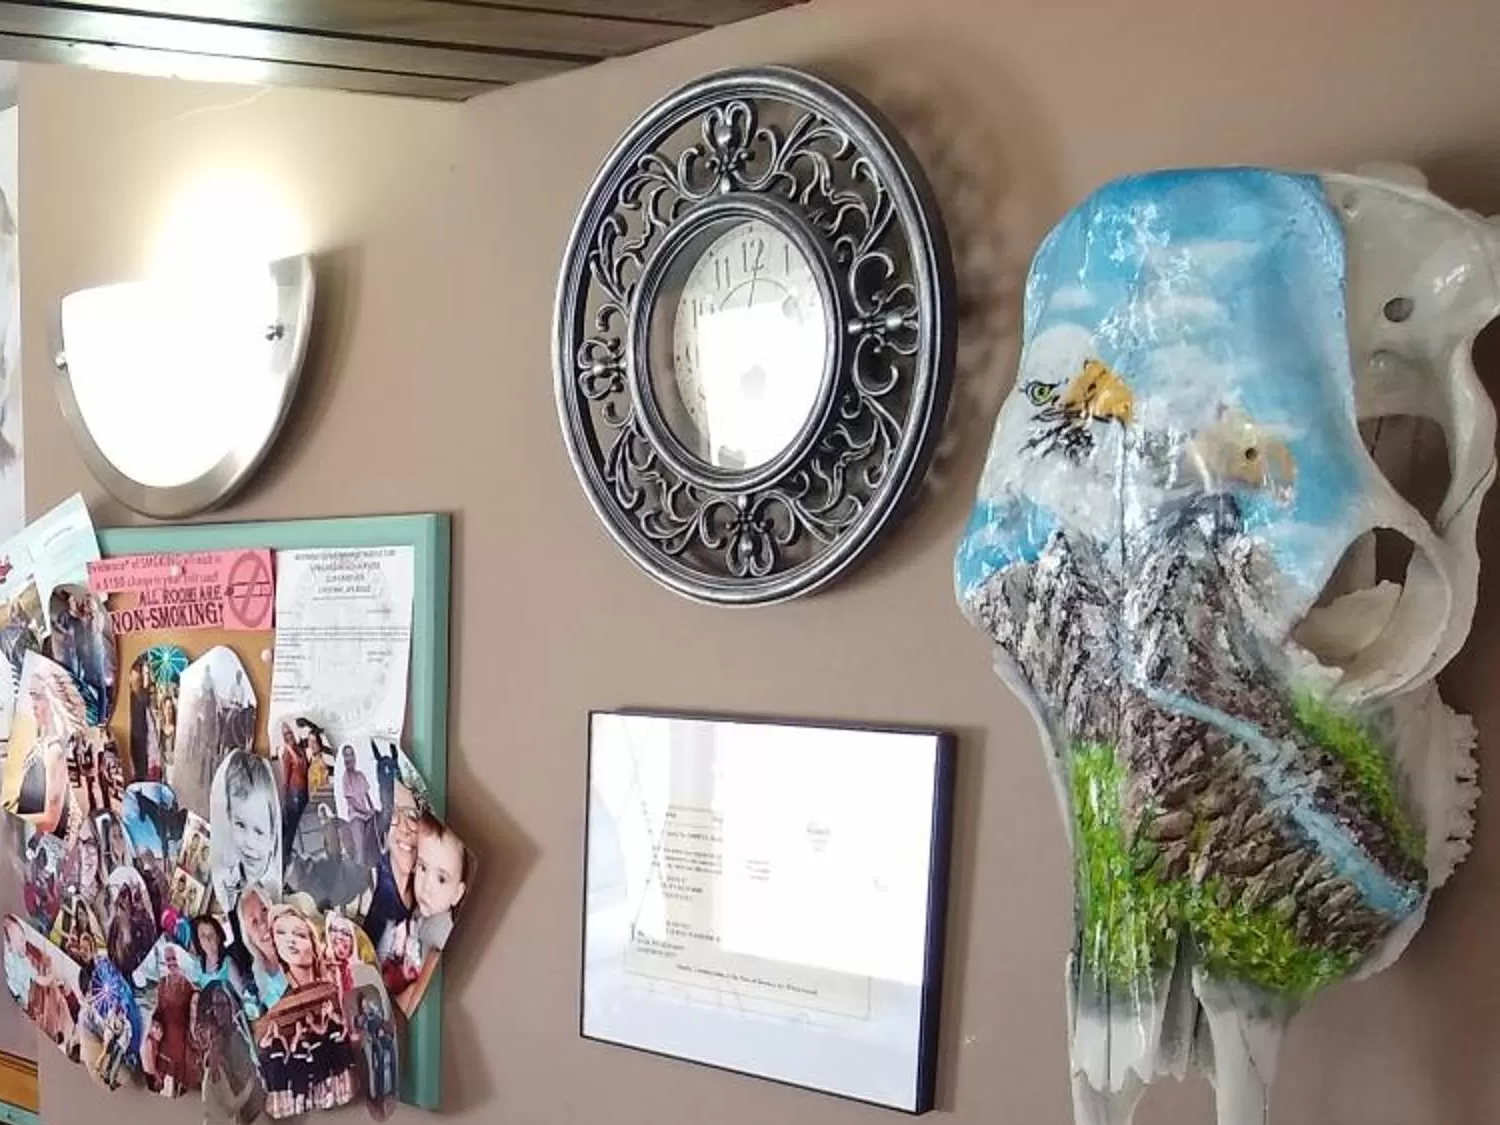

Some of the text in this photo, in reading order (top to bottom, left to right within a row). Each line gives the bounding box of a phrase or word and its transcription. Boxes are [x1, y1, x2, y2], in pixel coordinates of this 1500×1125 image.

[741, 239, 765, 272] 12
[714, 256, 731, 290] 11
[139, 589, 160, 606] ALL
[199, 584, 223, 601] ARE
[111, 603, 224, 634] NON-SMOKING!
